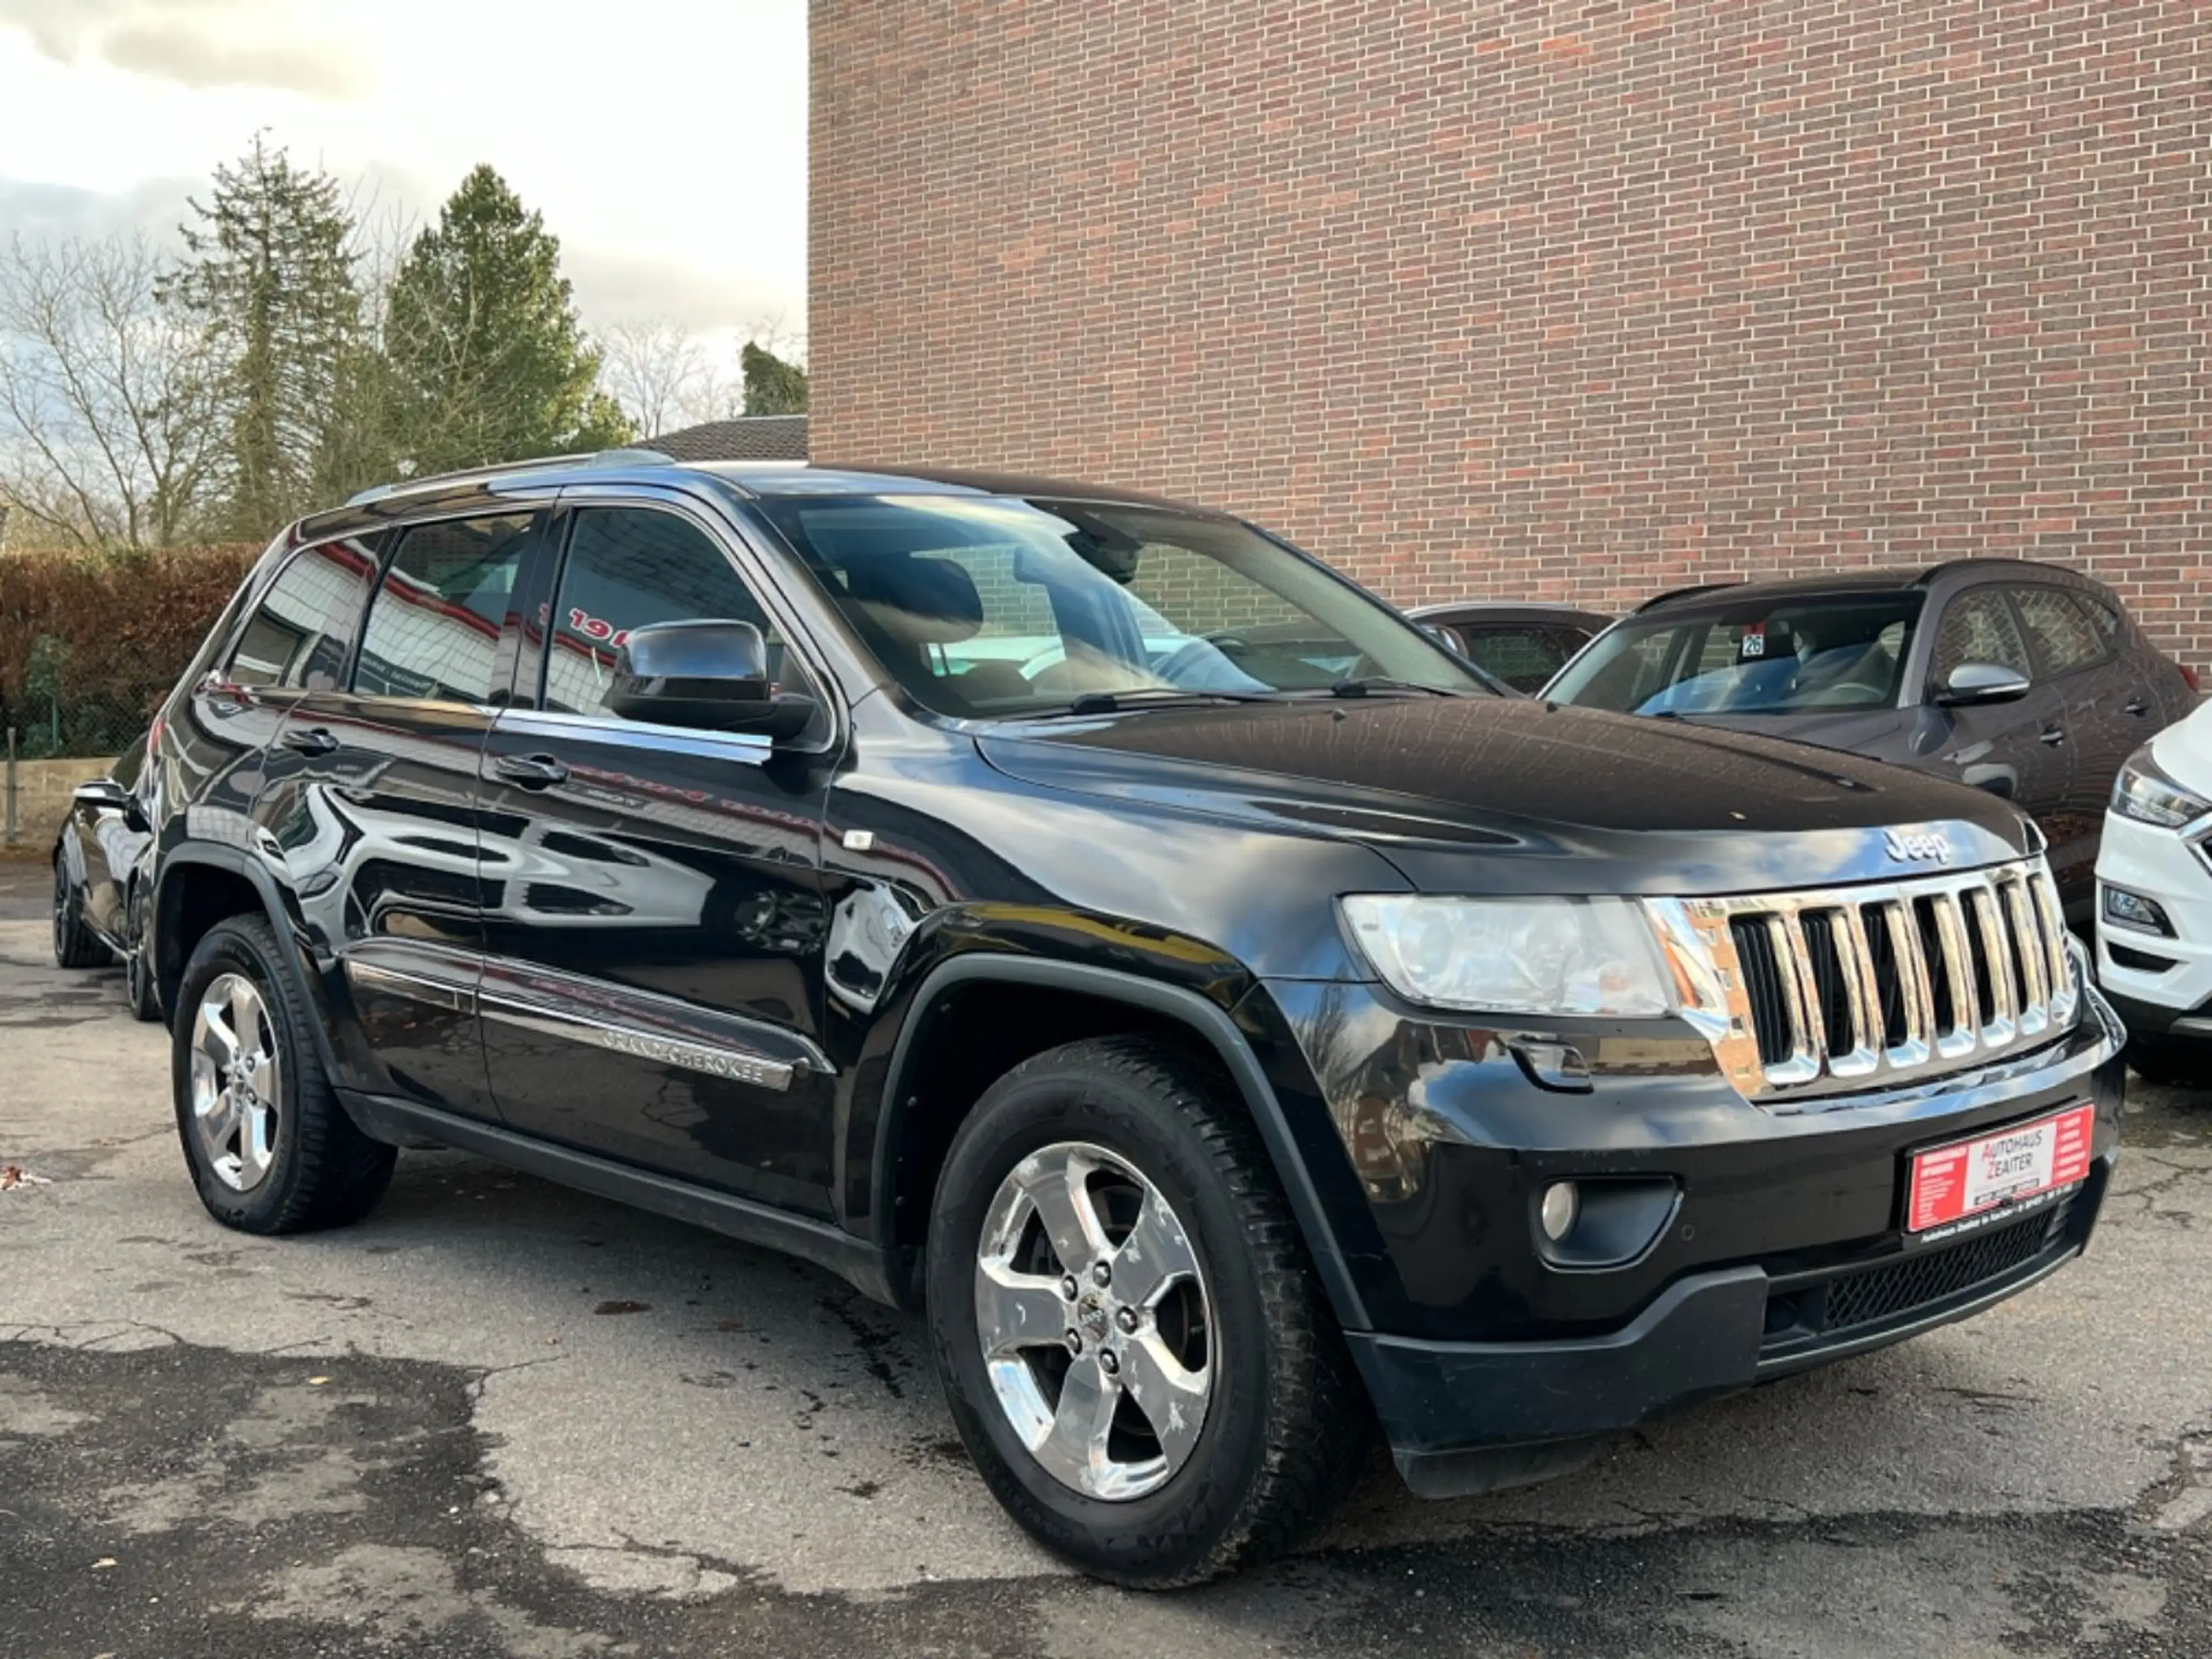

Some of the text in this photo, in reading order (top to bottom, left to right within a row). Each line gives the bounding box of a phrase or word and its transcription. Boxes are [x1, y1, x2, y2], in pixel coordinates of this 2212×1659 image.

[1881, 828, 1949, 865] Jeep
[668, 1047, 763, 1084] CHEROKEE
[1982, 1129, 2043, 1161] AUTOHAUS
[1987, 1152, 2033, 1180] ZEAITER
